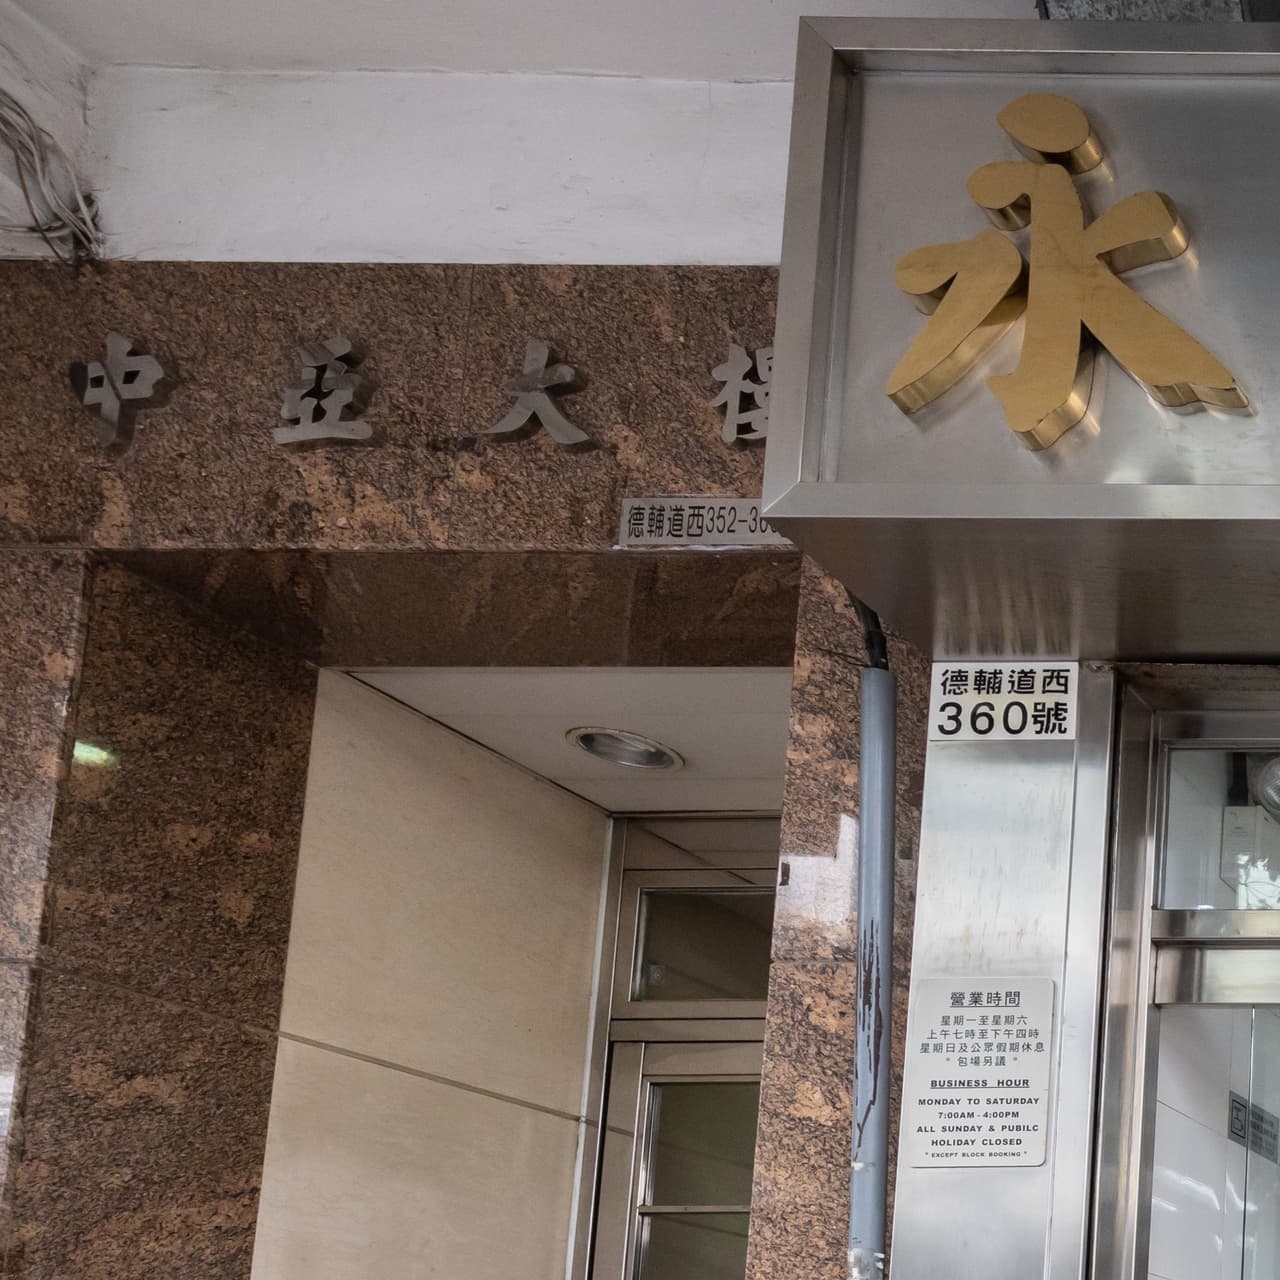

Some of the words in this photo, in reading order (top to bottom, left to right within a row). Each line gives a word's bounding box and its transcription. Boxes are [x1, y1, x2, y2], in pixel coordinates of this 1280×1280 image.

[628, 505, 778, 538] 德輔道西352-36
[941, 669, 1070, 695] 德輔道西
[937, 701, 1068, 735] 360號
[950, 991, 1020, 1006] 營業時間
[940, 1015, 1028, 1026] 星期一至星期六
[927, 1029, 1039, 1040] 上午七時至下午四時
[930, 1079, 988, 1088] BUSINESS
[997, 1079, 1030, 1087] HOUR
[918, 1098, 961, 1106] MONDAY
[986, 1097, 1040, 1105] SATURDAY
[938, 1111, 975, 1119] 7:00AM
[983, 1111, 1019, 1119] 4:00PM
[917, 1125, 935, 1133] ALL
[941, 1125, 982, 1133] SUNDAY
[931, 1138, 976, 1146] HOLIDAY
[982, 1138, 1022, 1146] CLOSED
